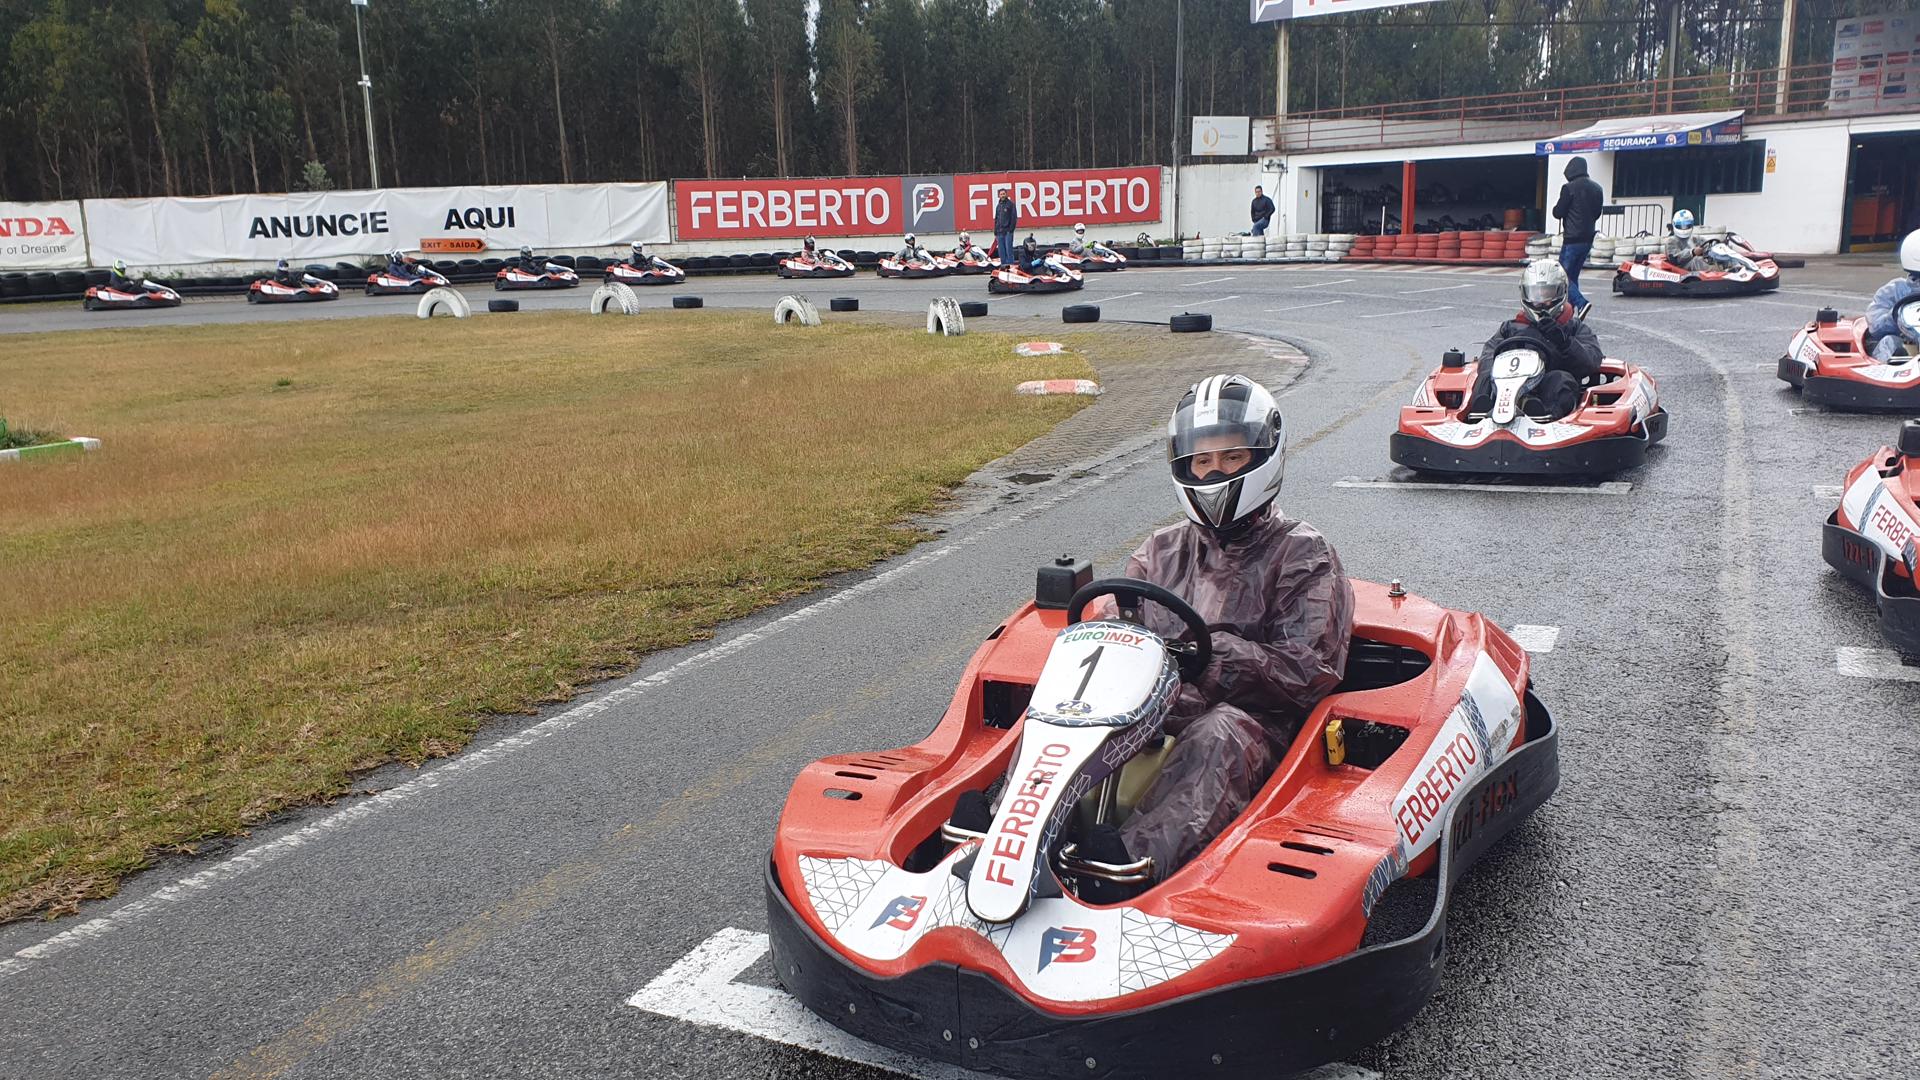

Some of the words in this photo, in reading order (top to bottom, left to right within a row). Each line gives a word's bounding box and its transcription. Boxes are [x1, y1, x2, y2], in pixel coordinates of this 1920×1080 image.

[1603, 136, 1657, 147] SEGURANÇA
[690, 187, 890, 229] FERBERTO
[248, 210, 389, 239] ANUNCIE
[444, 206, 516, 230] AQUI
[21, 244, 67, 255] Dreams
[421, 241, 442, 249] EXIT
[449, 240, 476, 249] SAÍDA
[1509, 356, 1520, 372] 9
[1063, 631, 1145, 645] EUROINDY
[1073, 645, 1104, 701] 1
[1396, 732, 1476, 845] ERBERTO
[985, 743, 1070, 886] FERBERTO
